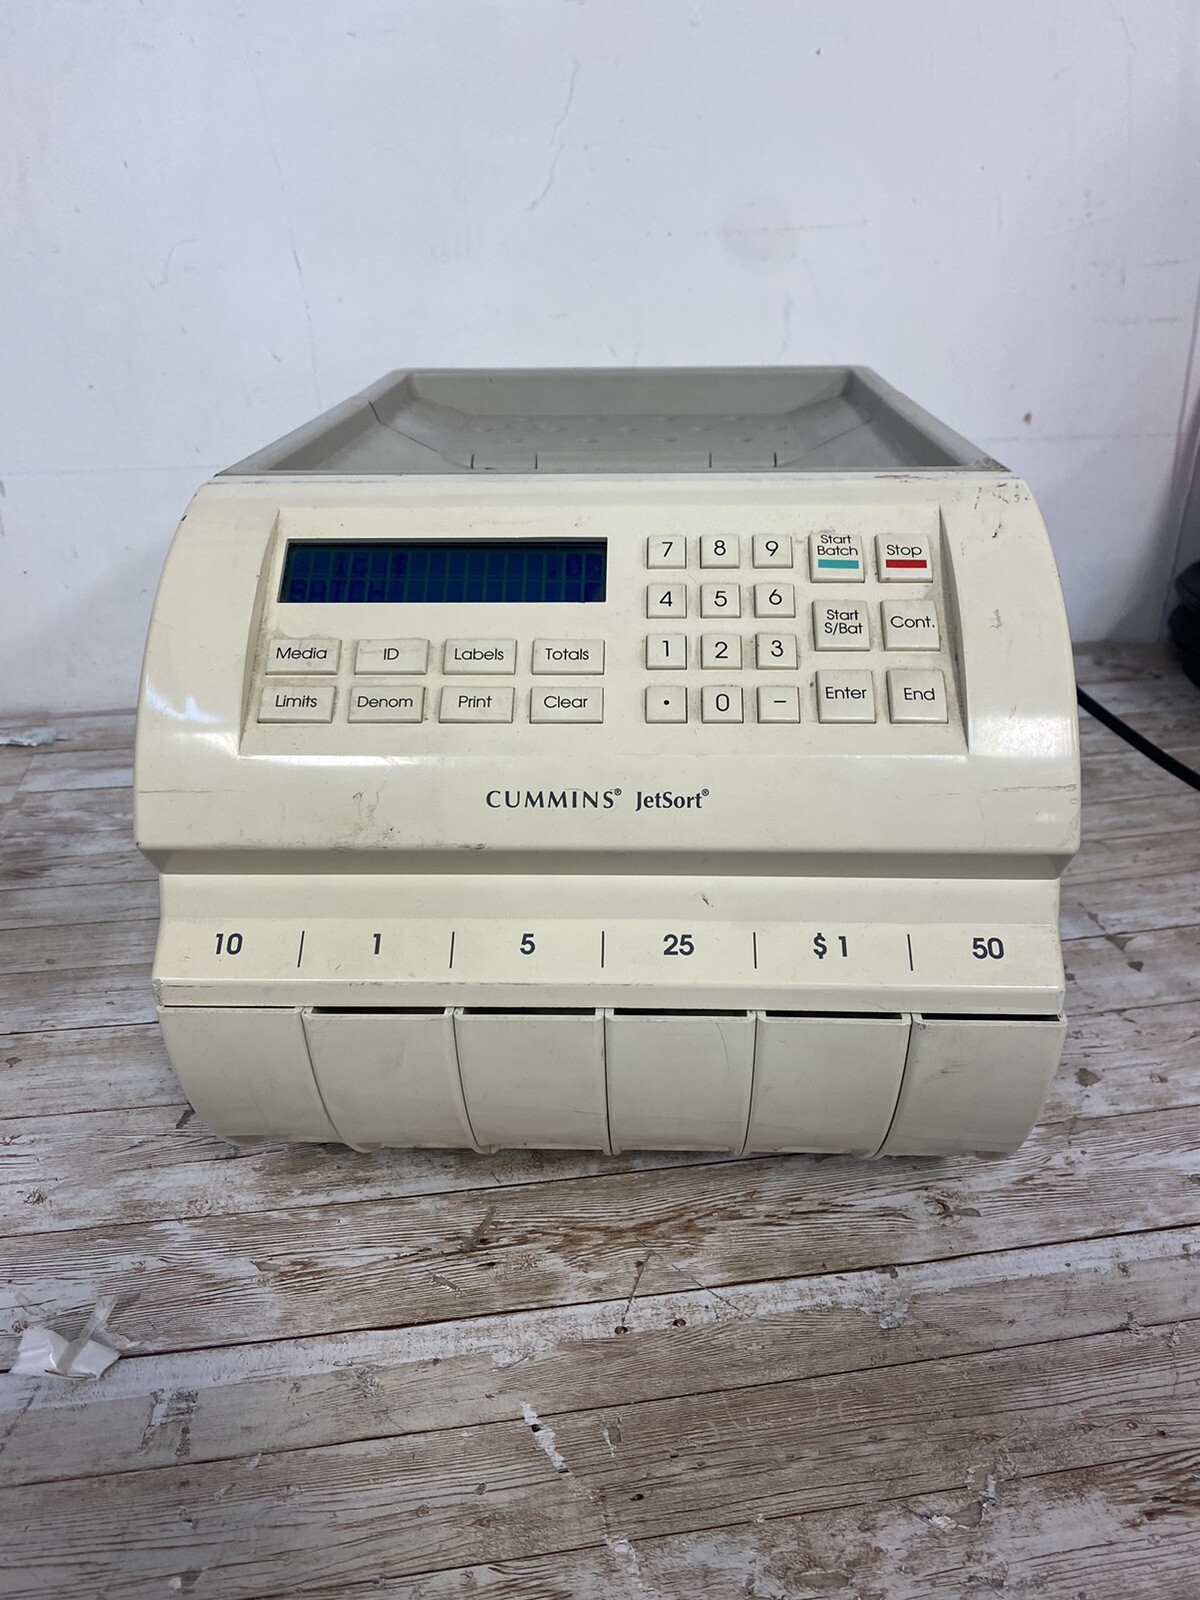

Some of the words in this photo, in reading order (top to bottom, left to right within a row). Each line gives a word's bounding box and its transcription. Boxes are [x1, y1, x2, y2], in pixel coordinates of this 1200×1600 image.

[820, 534, 852, 545] Start
[661, 541, 674, 558] 7
[713, 539, 727, 557] 8
[765, 540, 779, 557] 9
[816, 545, 859, 556] Batch
[886, 544, 923, 558] Stop
[289, 579, 385, 601] BATCH
[768, 588, 783, 606] 6
[659, 590, 673, 607] 4
[714, 590, 728, 608] 5
[826, 608, 860, 621] Start
[890, 615, 936, 629] Cont.
[824, 621, 864, 636] S/Bat
[275, 647, 328, 660] Media
[383, 647, 400, 661] ID
[454, 647, 505, 661] Labels
[545, 647, 590, 661] Totals
[662, 640, 670, 658] 1
[714, 641, 729, 659] 2
[770, 639, 784, 658] 3
[275, 694, 318, 708] Limits
[825, 686, 867, 700] Enter
[903, 687, 936, 701] End
[357, 695, 414, 708] Denom
[458, 695, 493, 708] Print
[543, 695, 589, 709] Clear
[715, 693, 730, 712] 0
[215, 932, 243, 956] 10
[373, 933, 382, 955] 1
[519, 933, 536, 956] 5
[663, 933, 695, 956] 25
[972, 937, 1005, 960] 50
